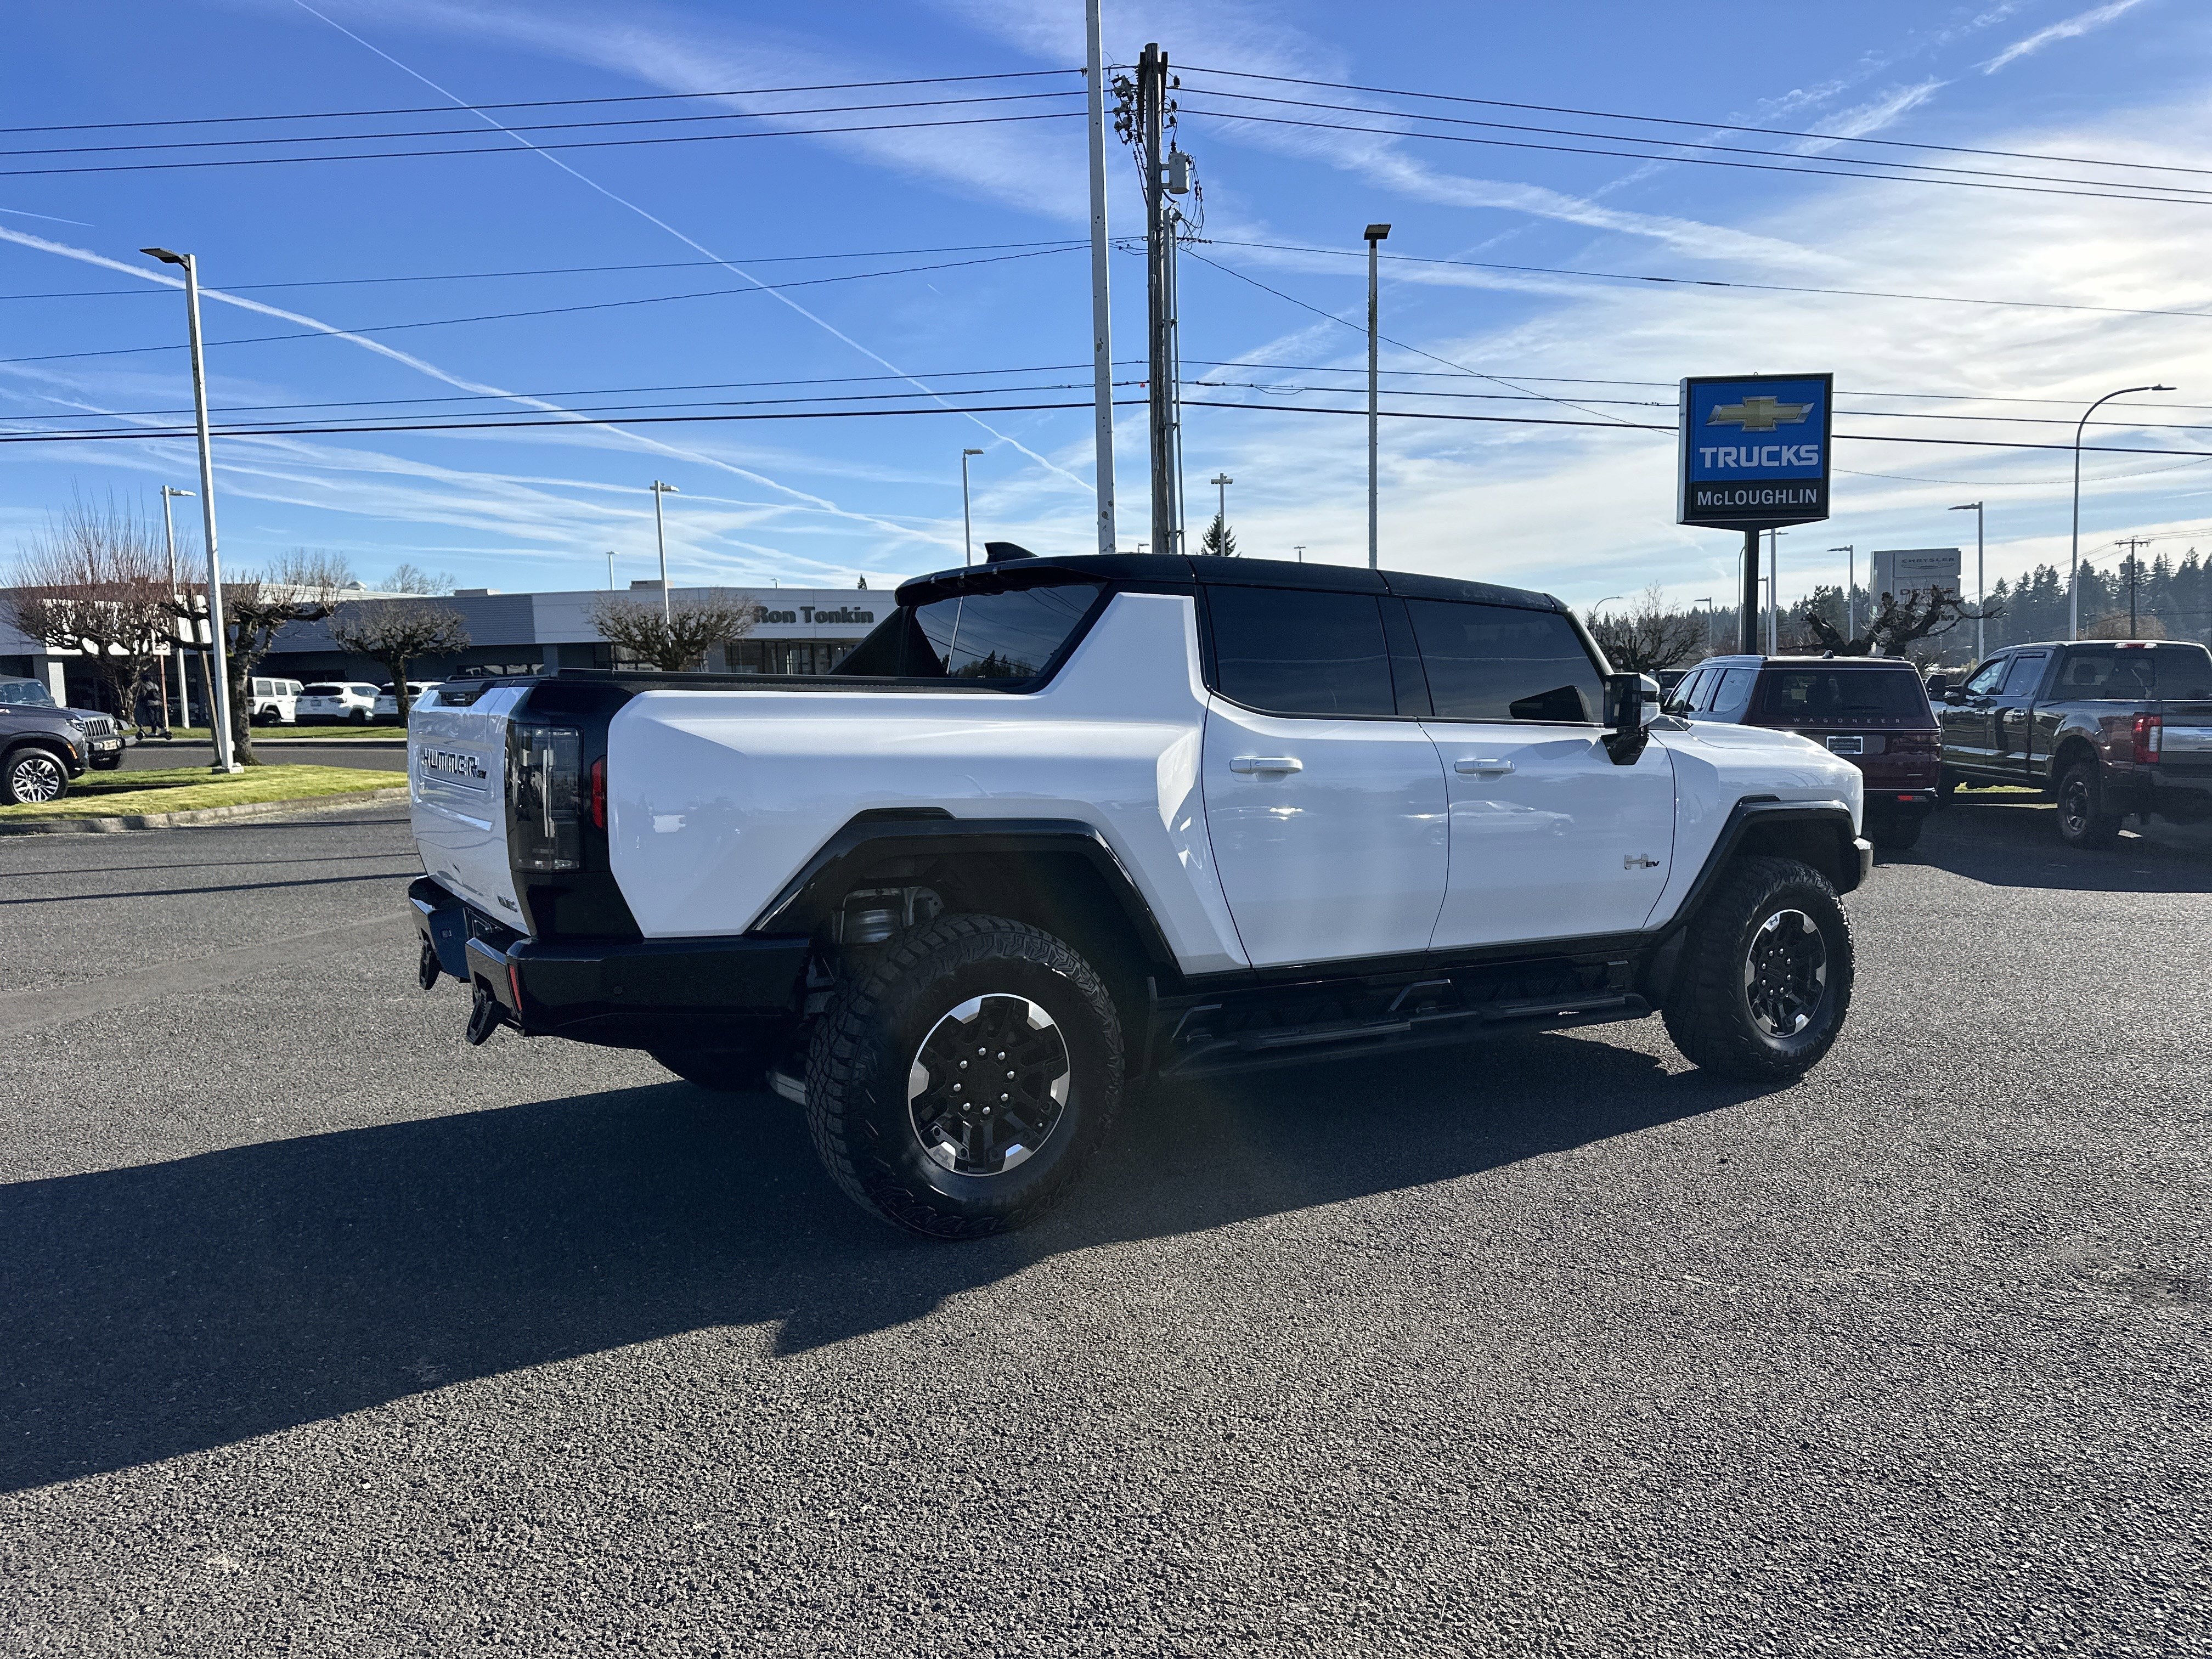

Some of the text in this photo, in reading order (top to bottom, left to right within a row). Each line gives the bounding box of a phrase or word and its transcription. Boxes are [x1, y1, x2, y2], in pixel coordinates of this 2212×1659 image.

[1699, 444, 1819, 468] TRUCKS
[1697, 488, 1818, 506] McLOUGHLIN
[754, 605, 874, 623] Ron Tonkin
[421, 747, 480, 778] HUMMER
